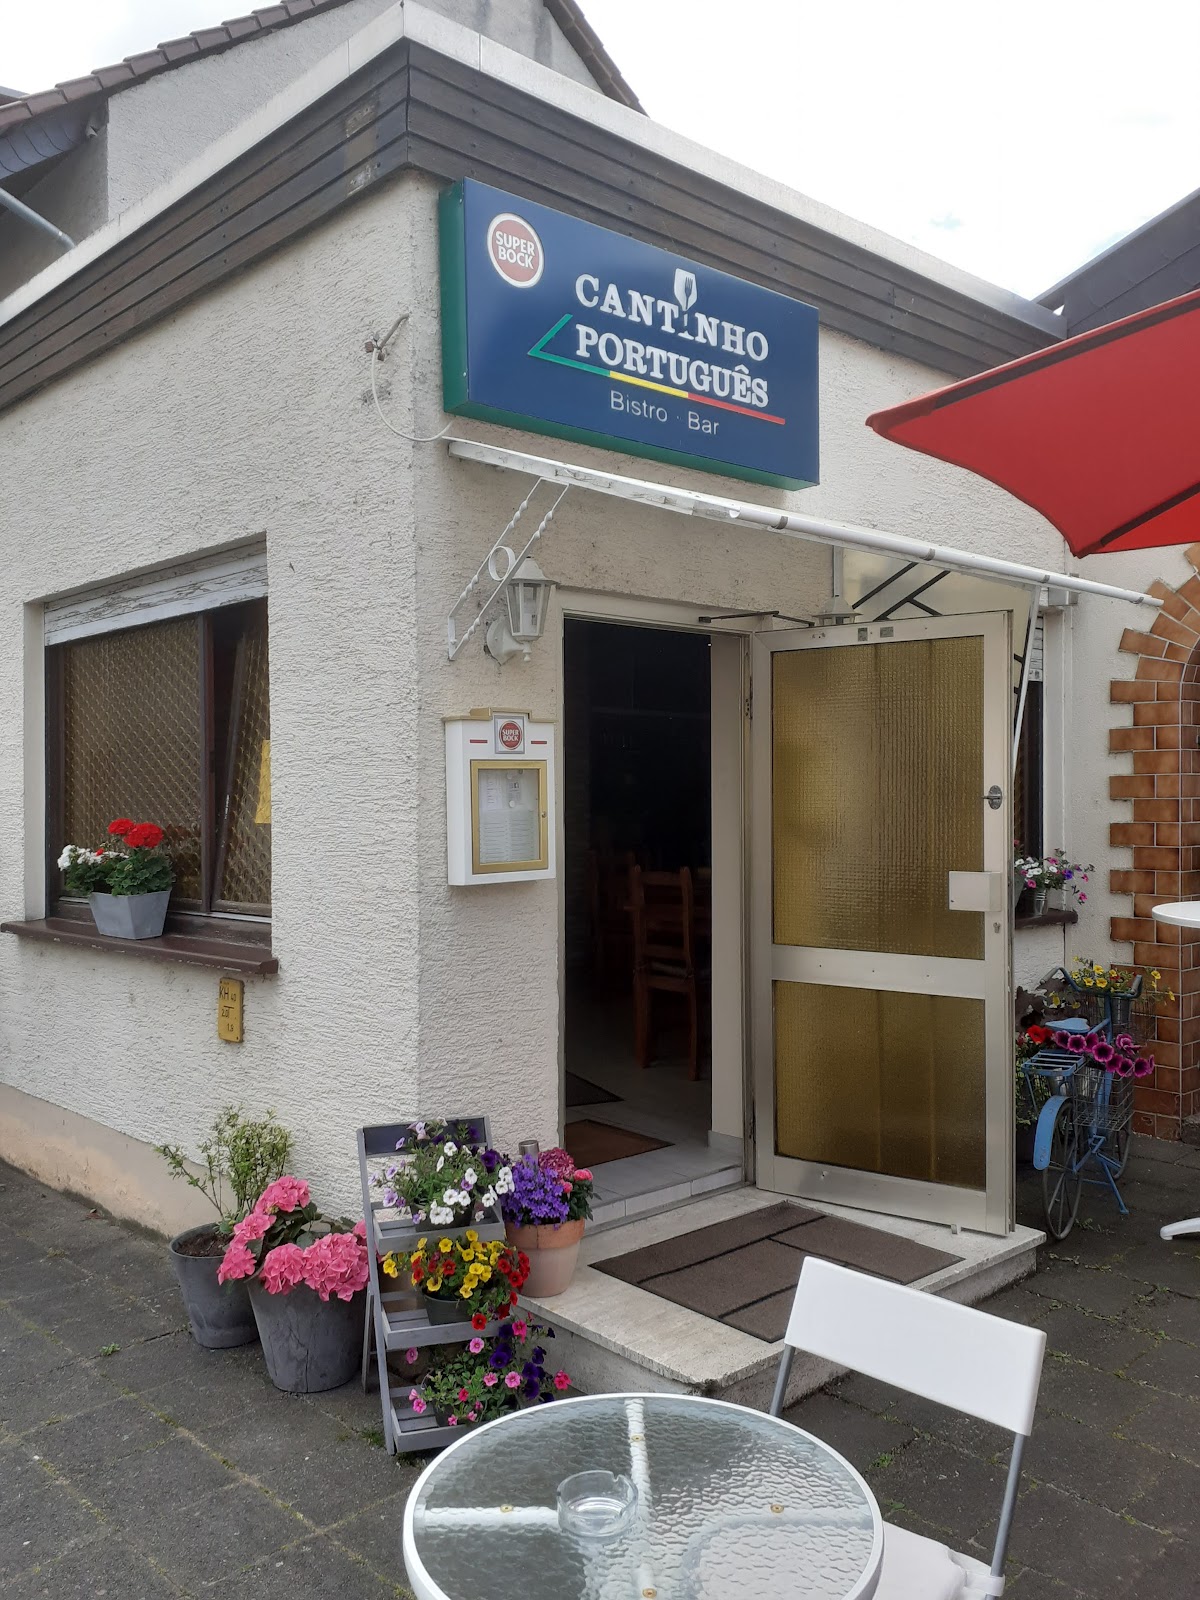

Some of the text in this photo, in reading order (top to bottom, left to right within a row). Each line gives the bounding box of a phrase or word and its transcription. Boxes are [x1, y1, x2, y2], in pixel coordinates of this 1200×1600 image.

[495, 230, 535, 256] SUPER
[498, 245, 534, 269] BOCK
[575, 273, 769, 361] CANTINHO
[575, 323, 769, 408] PORTUGUÊS
[610, 389, 719, 435] Bistro Bar
